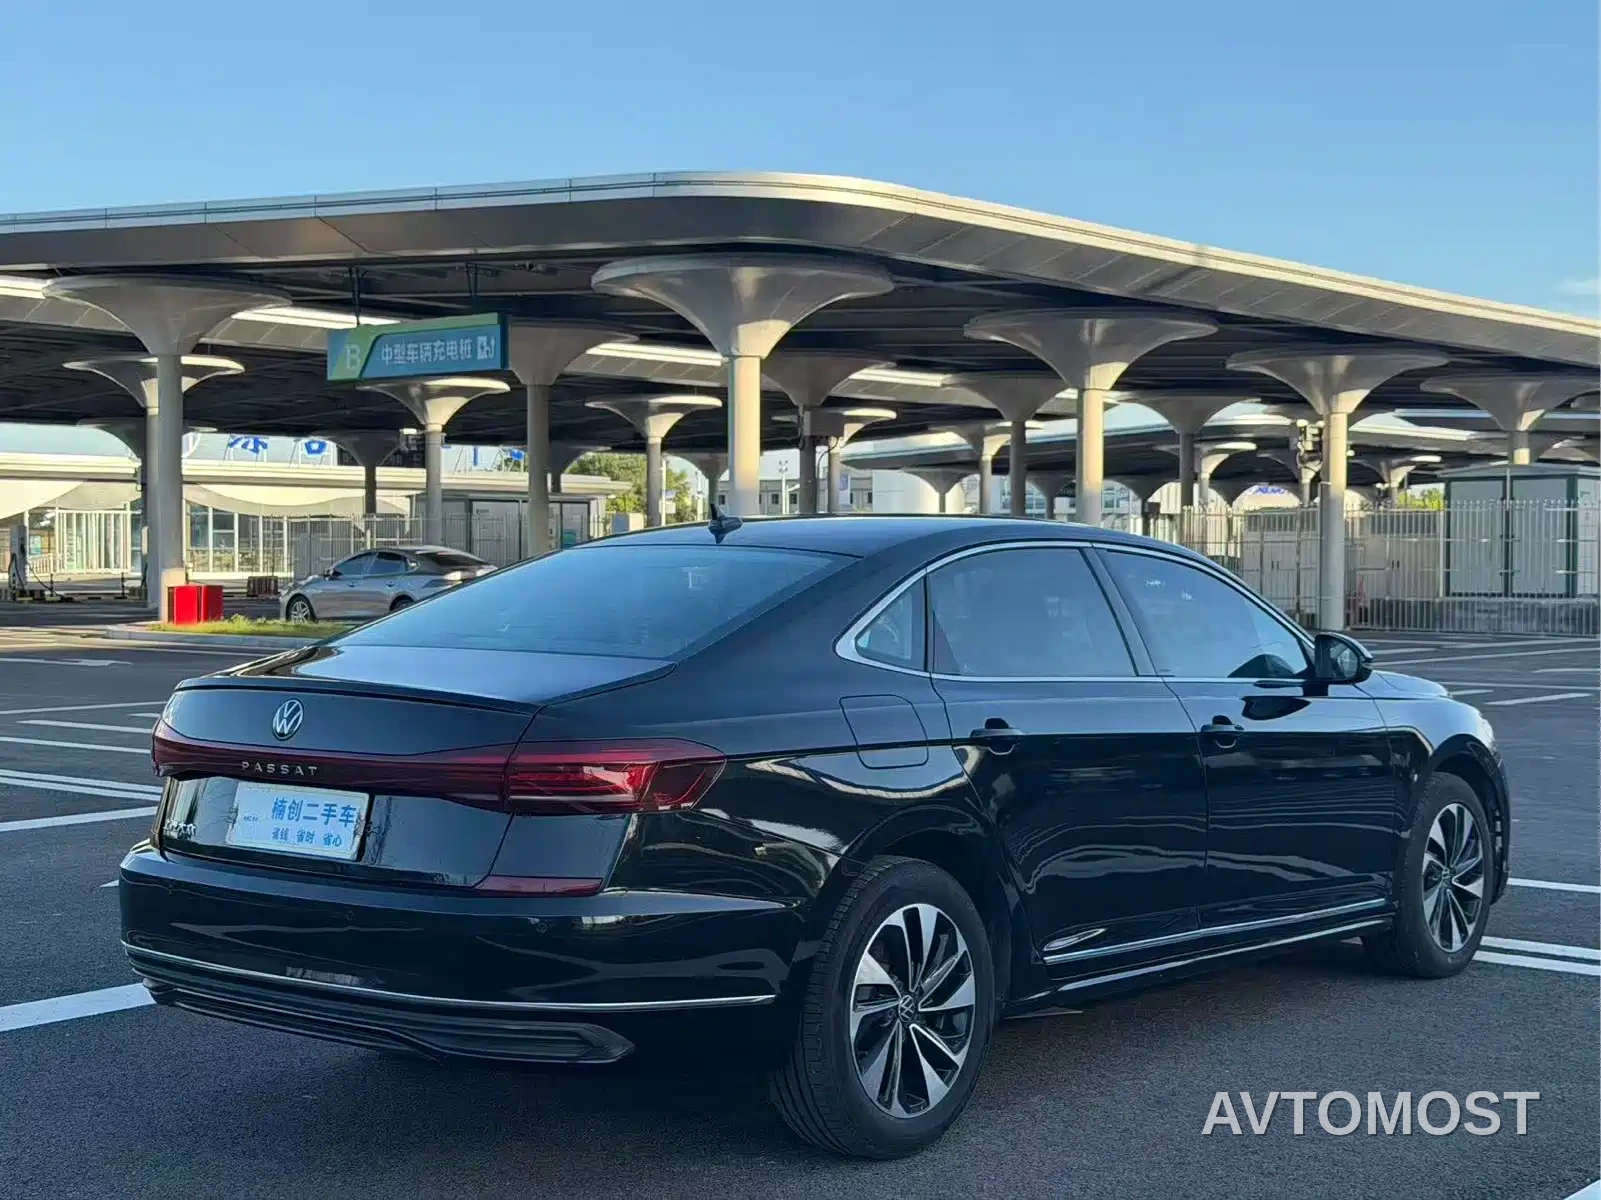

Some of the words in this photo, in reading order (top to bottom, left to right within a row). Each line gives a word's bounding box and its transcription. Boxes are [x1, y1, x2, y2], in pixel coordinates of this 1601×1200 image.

[345, 344, 361, 369] B
[241, 761, 318, 776] PASSAT
[271, 797, 357, 828] 楠创二手车
